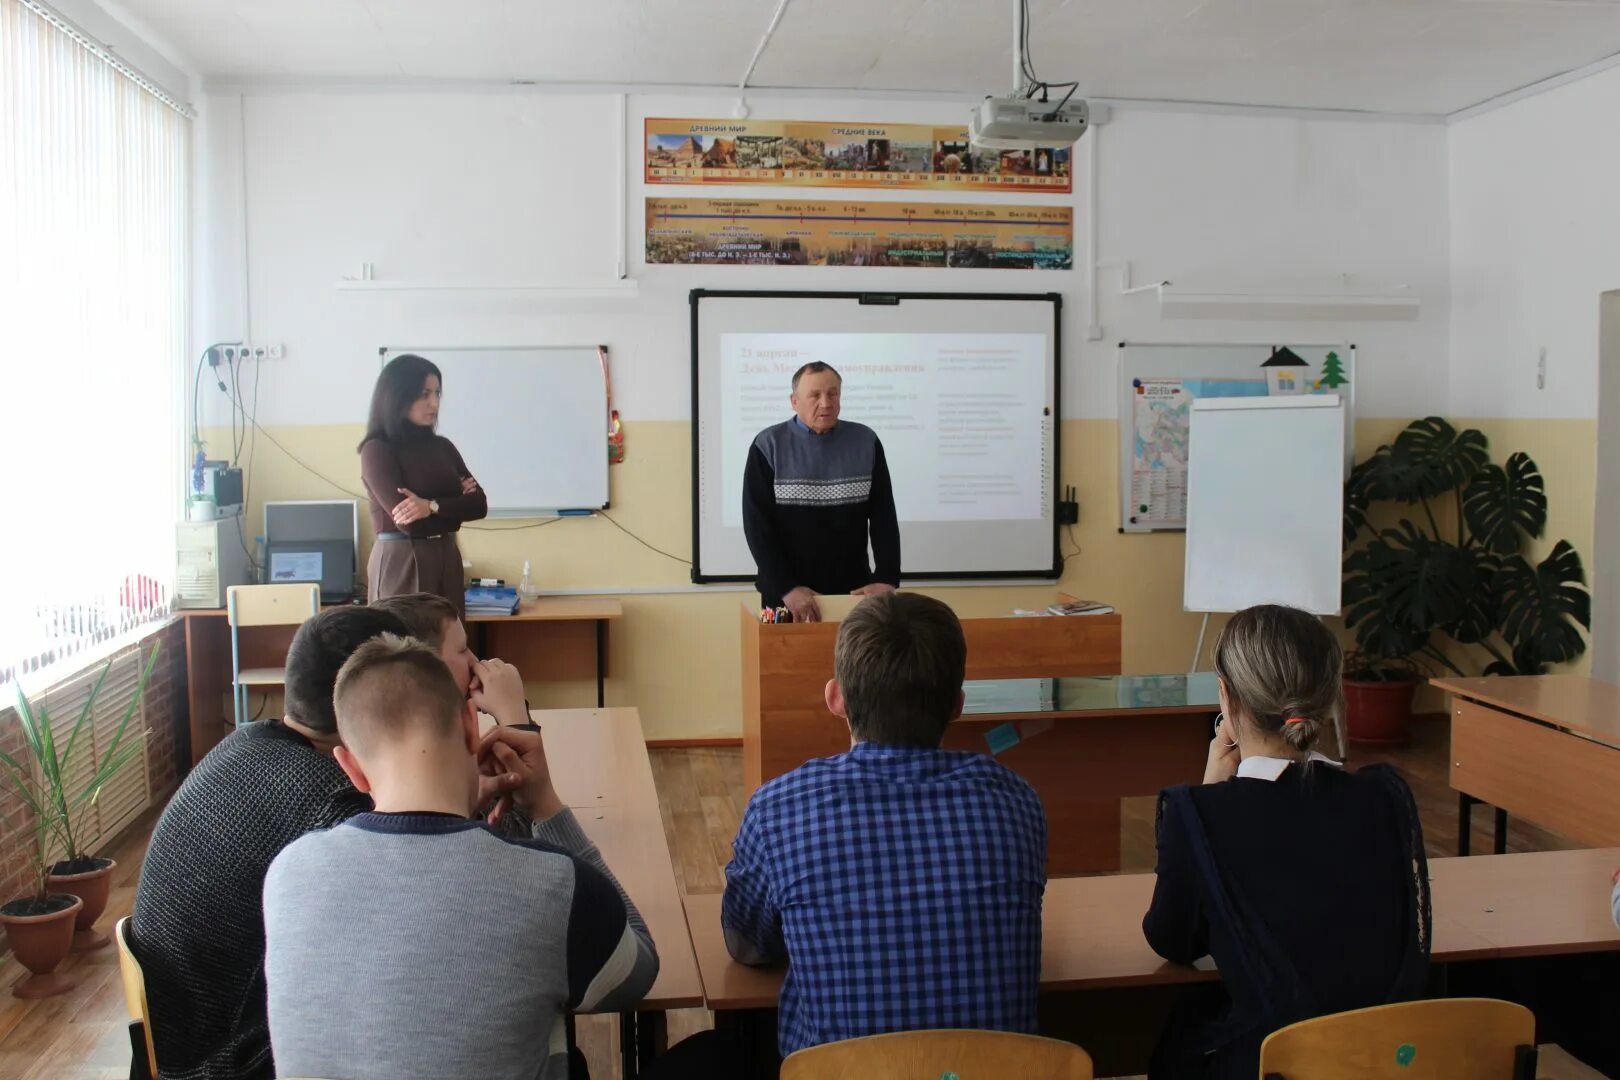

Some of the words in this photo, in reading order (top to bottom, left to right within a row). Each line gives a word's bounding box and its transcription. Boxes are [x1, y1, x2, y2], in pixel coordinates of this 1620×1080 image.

[689, 124, 727, 133] ДРЕВНИЙ
[728, 125, 747, 133] МИР
[831, 128, 865, 136] СРЕДНИЕ
[867, 128, 886, 136] ВЕКА
